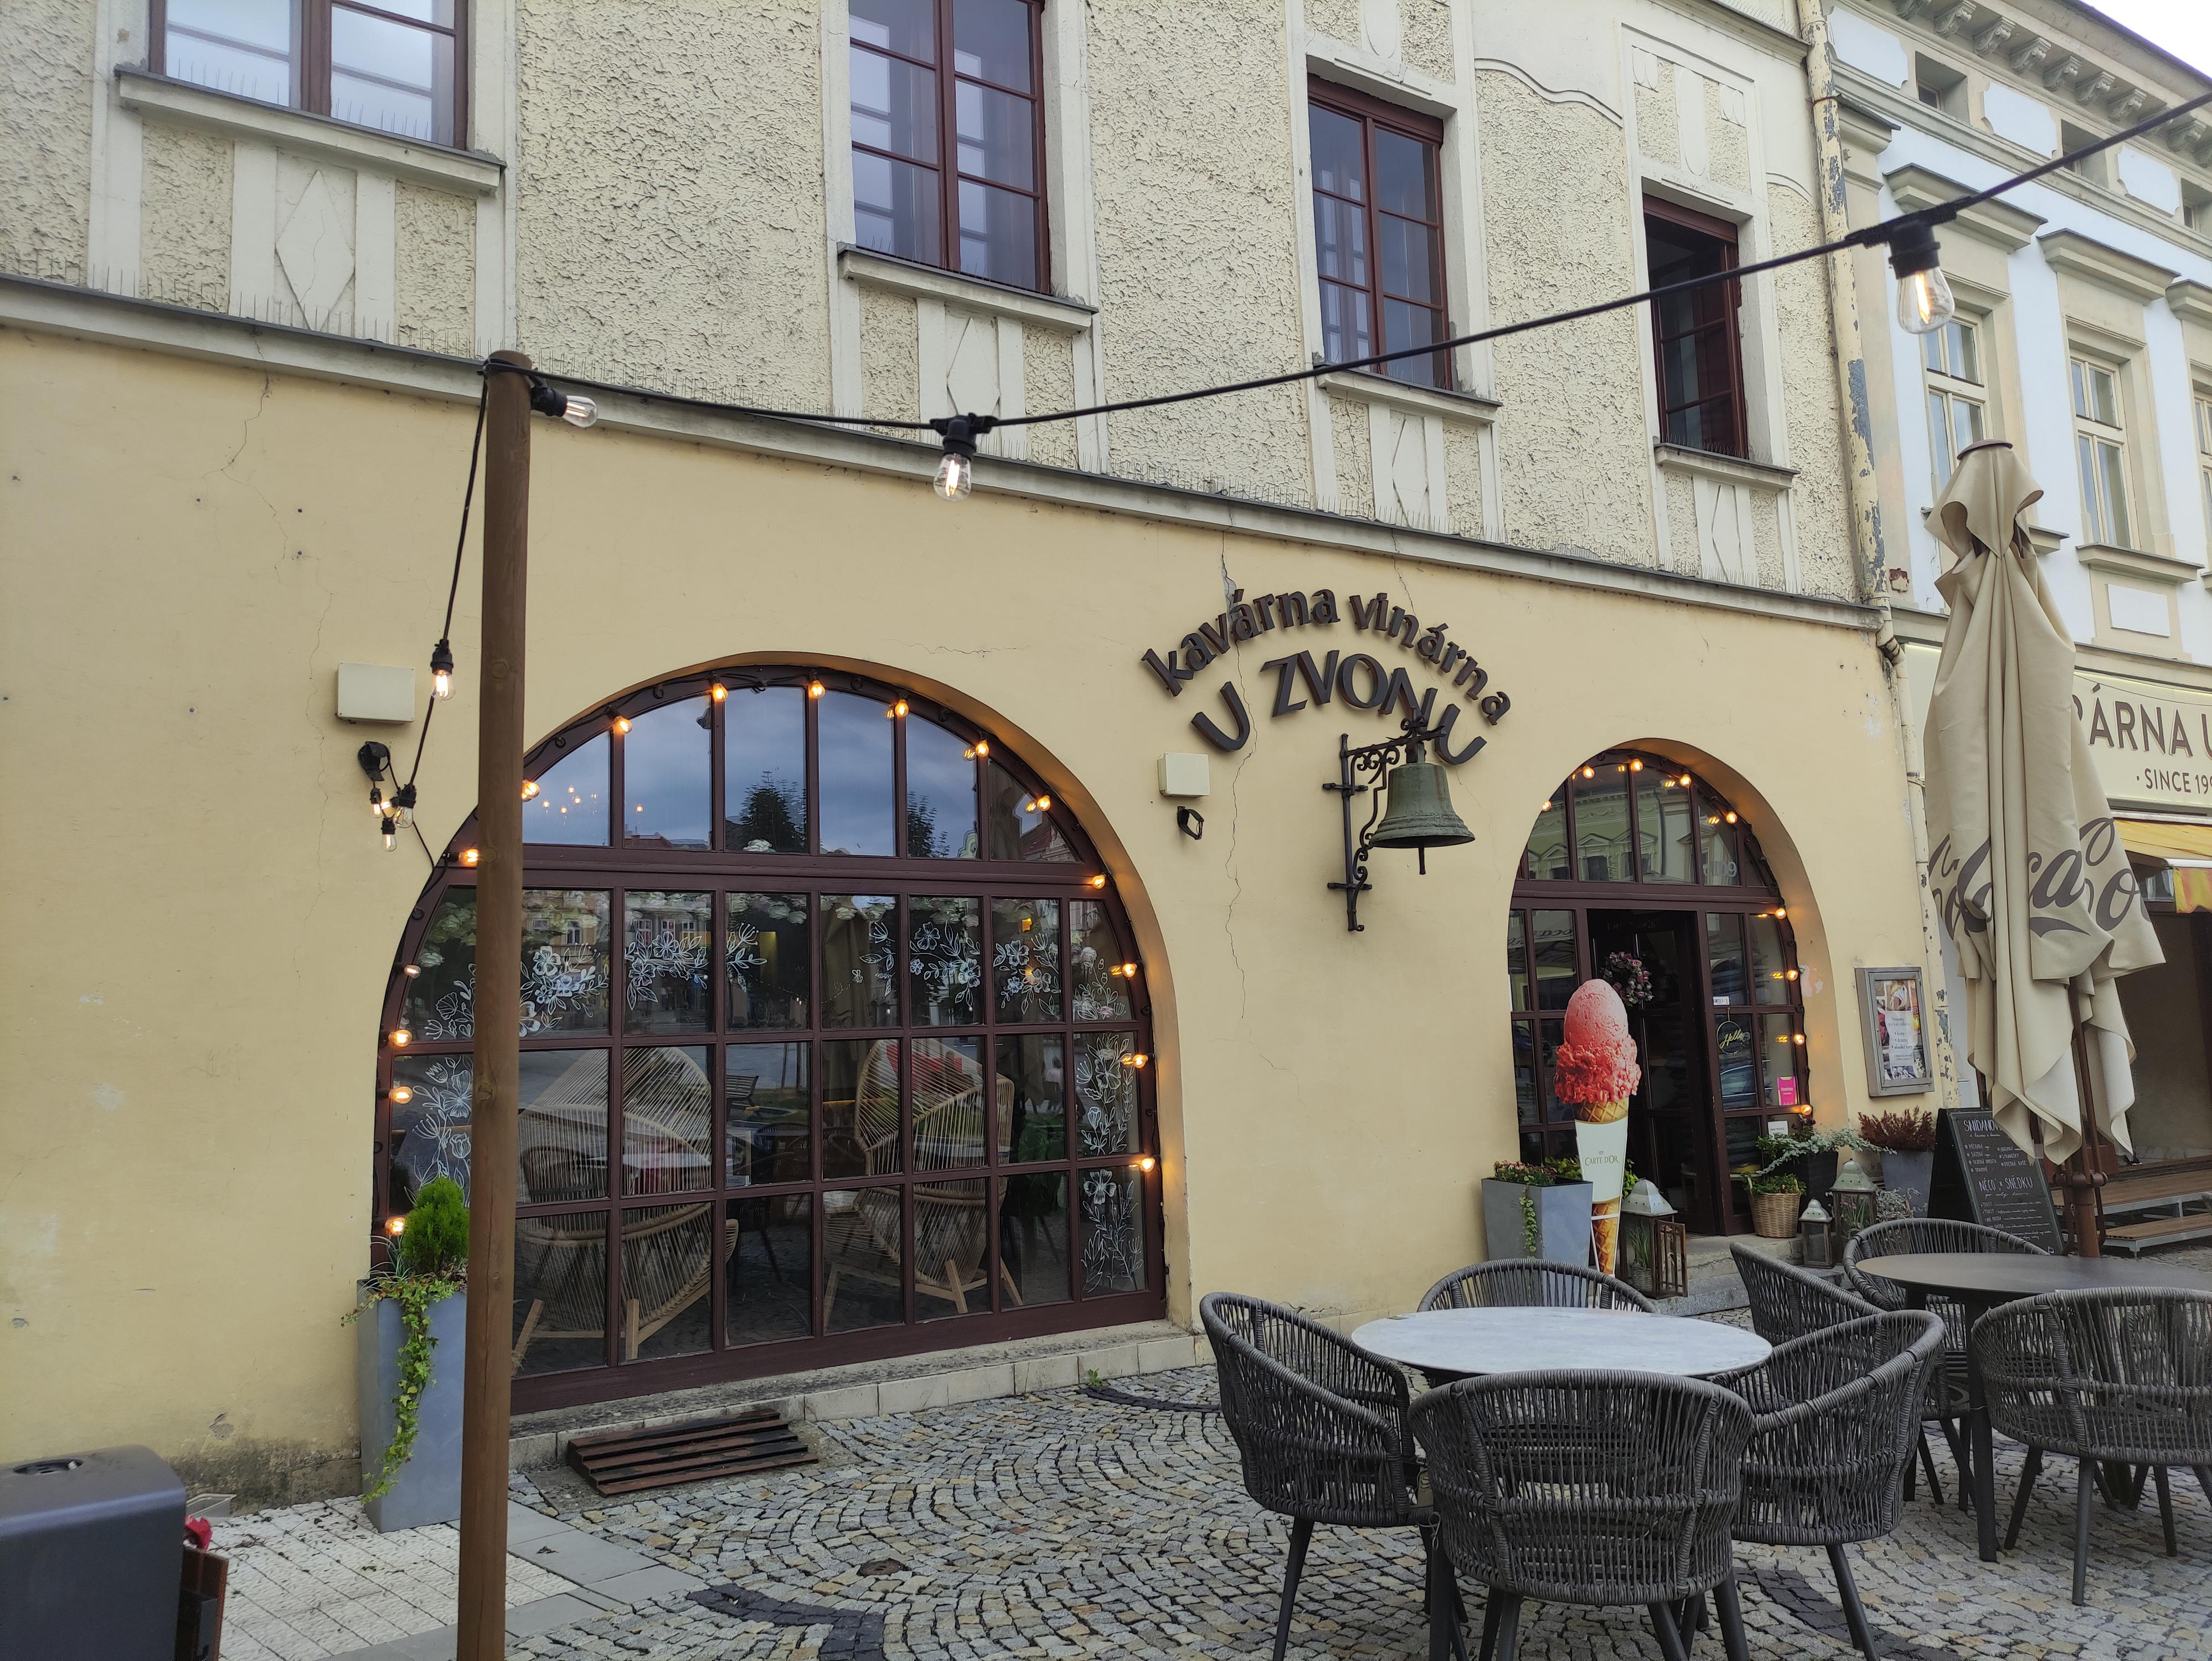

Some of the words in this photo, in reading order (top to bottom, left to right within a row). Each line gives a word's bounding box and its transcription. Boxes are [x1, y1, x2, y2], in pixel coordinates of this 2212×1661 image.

[1141, 589, 1340, 697] kavárna
[1349, 592, 1511, 725] vinárna
[1191, 682, 1250, 752] U
[1260, 650, 1487, 765] ZVONU
[2072, 683, 2193, 757] ÁRNA
[2144, 768, 2192, 793] SINCE
[2195, 775, 2212, 795] 19
[1719, 1029, 1744, 1049] Hello
[1963, 1118, 2002, 1132] SNÍDANO
[1585, 1157, 1602, 1166] CARTE
[1605, 1155, 1621, 1164] D'OR
[2005, 1175, 2033, 1189] SNĚDKU
